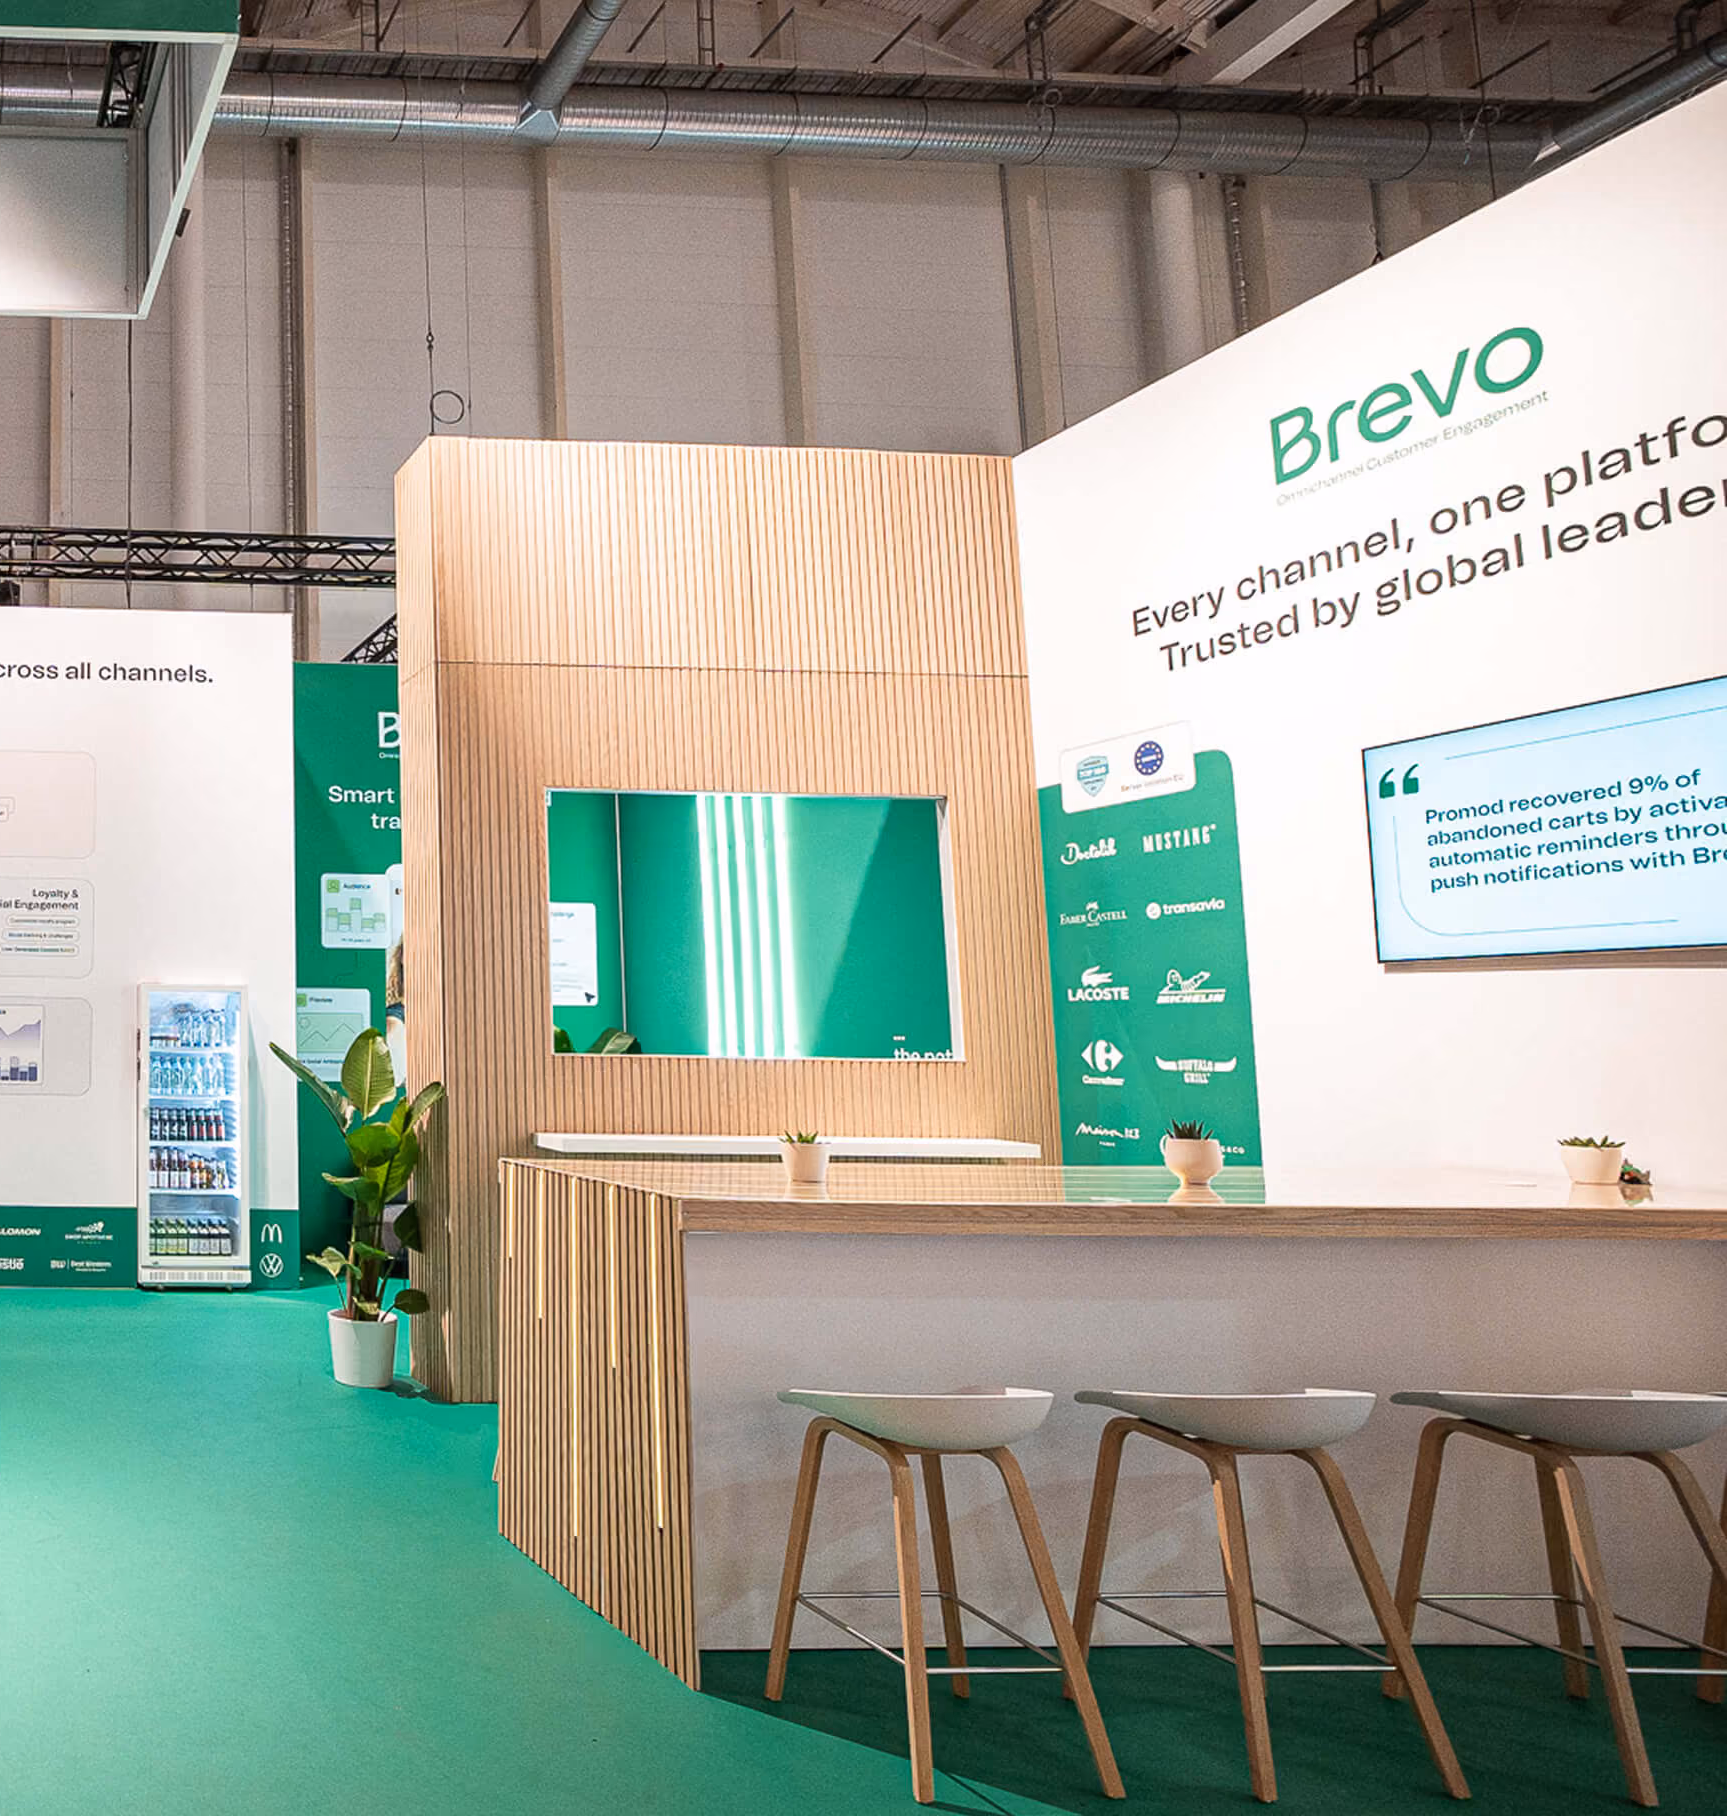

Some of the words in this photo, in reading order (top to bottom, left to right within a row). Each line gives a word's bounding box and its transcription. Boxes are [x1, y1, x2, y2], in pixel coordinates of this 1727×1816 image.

[1270, 327, 1544, 485] Brevo
[1276, 461, 1364, 506] Omnichannel
[1366, 436, 1439, 471] Customer
[1442, 391, 1549, 441] Engagement
[1132, 586, 1225, 637] Every
[1236, 517, 1414, 601] channel,
[1430, 484, 1525, 535] one
[1160, 604, 1300, 671] Trusted
[1312, 592, 1360, 628] by
[1376, 533, 1524, 616] global
[1542, 479, 1727, 559] leade
[65, 662, 91, 680] all
[98, 663, 214, 683] channels.
[328, 785, 395, 804] Smart
[1426, 799, 1504, 824] Promod
[1509, 781, 1622, 812] recovered
[1628, 774, 1669, 794] 9%
[1675, 768, 1701, 788] of
[1142, 826, 1211, 853] MUSTANG
[1427, 817, 1542, 846] abandoned
[1548, 811, 1608, 830] carts
[1614, 806, 1642, 824] by
[1429, 843, 1532, 868] automatic
[1537, 831, 1658, 855] reminders
[1431, 872, 1478, 893] push
[1484, 860, 1624, 884] notifications
[1630, 850, 1685, 870] with
[14, 900, 79, 910] Engagement
[33, 889, 70, 899] Loyalty
[72, 889, 79, 898] &
[1162, 898, 1225, 915] transavia
[1067, 986, 1129, 1002] LACOSTE
